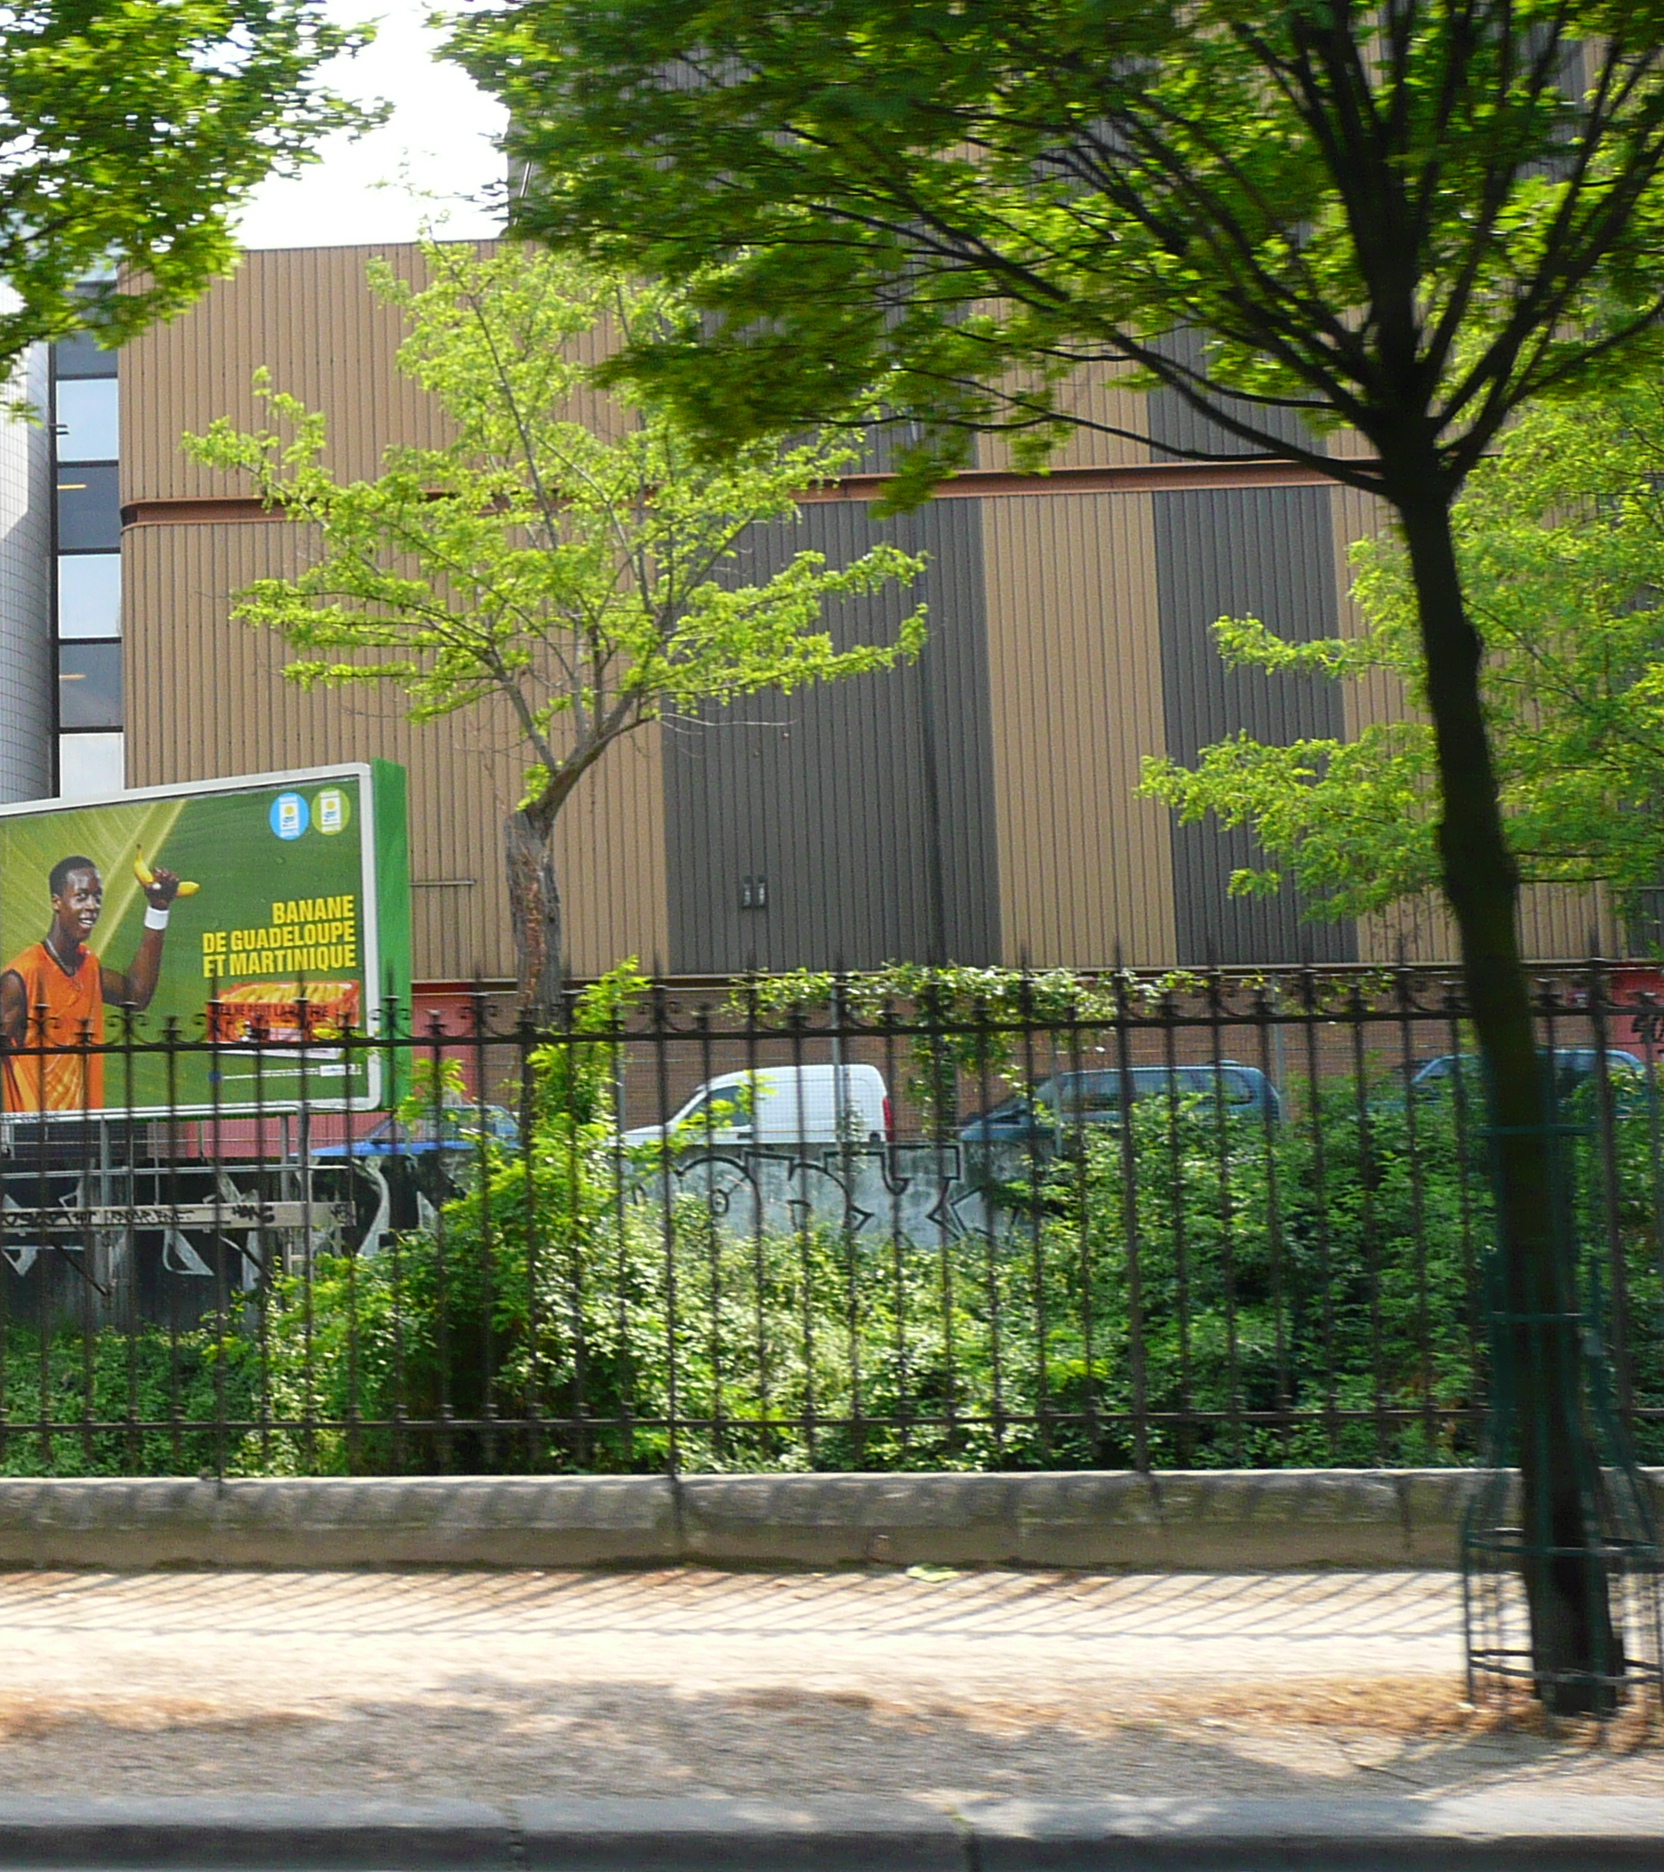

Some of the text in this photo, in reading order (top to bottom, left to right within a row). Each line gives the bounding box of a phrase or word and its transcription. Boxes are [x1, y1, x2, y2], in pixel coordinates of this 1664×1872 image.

[272, 895, 355, 924] BANANE
[202, 921, 356, 953] DE GUADELOUPE
[203, 945, 357, 978] ET MARTINIQUE
